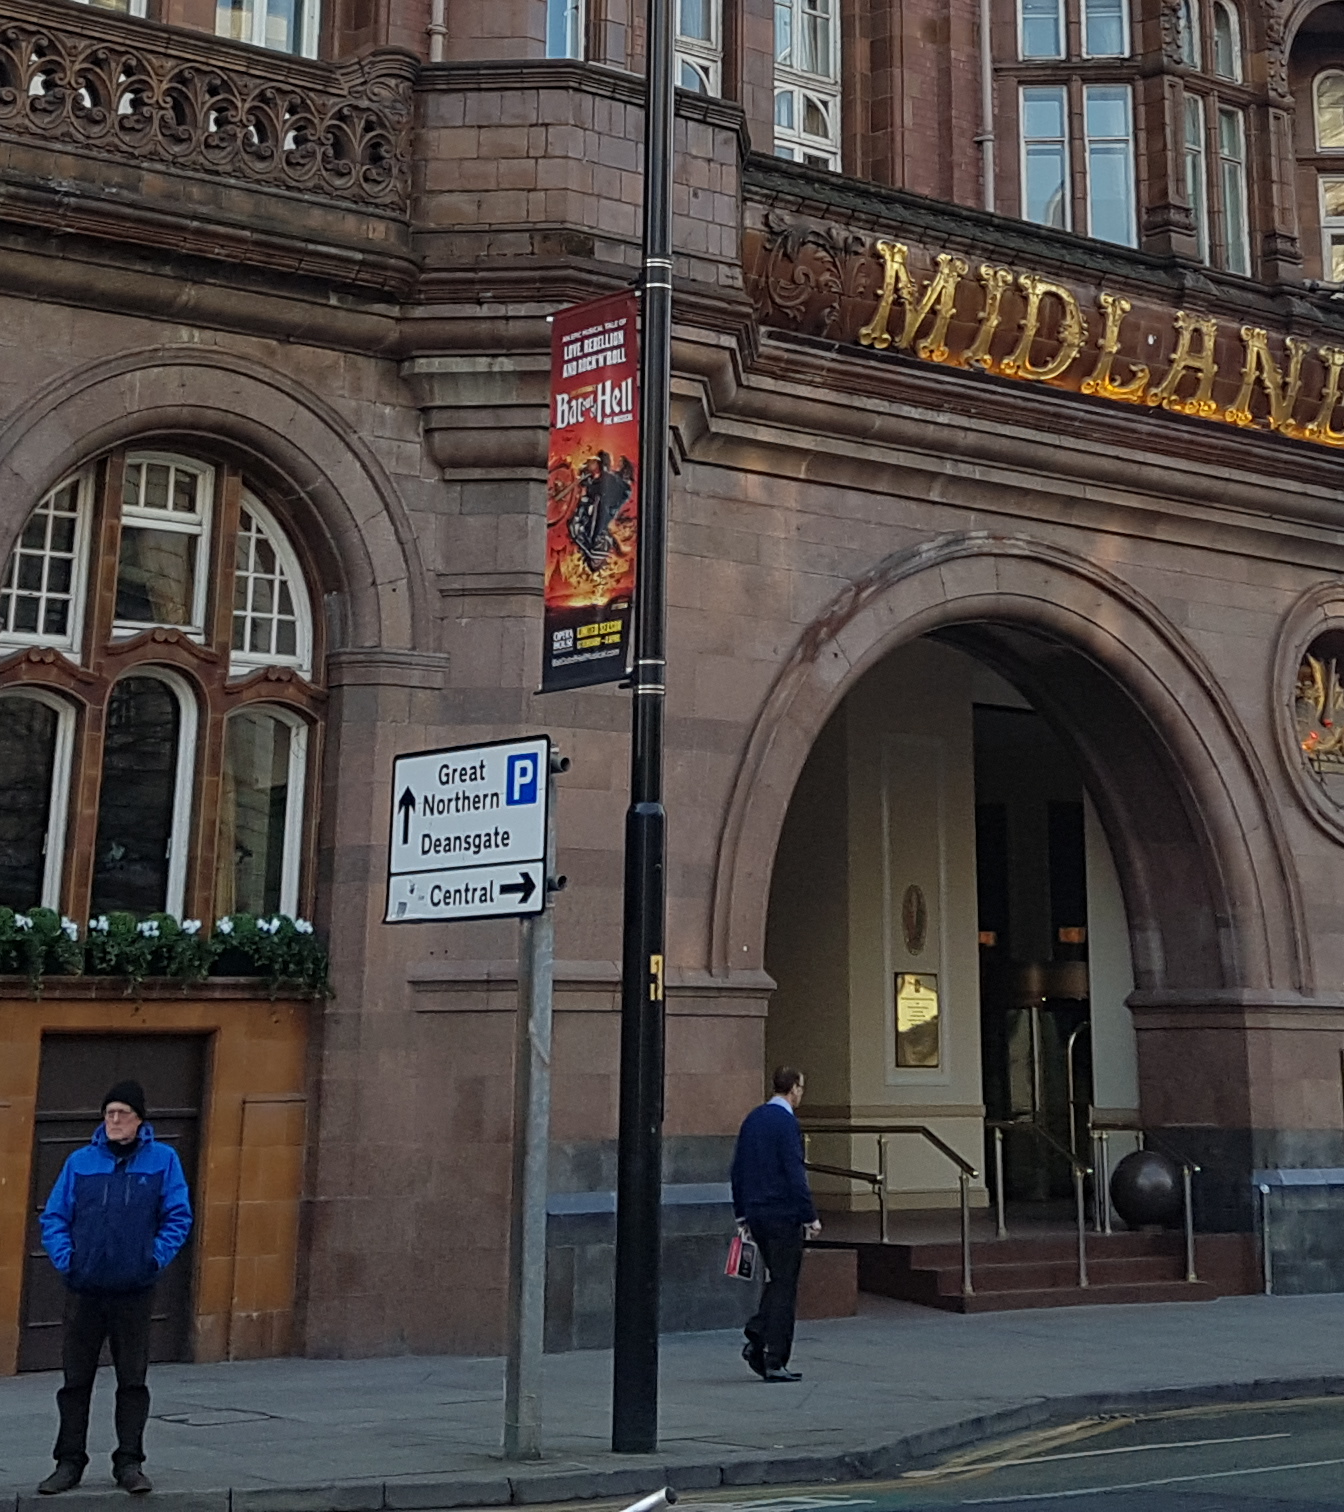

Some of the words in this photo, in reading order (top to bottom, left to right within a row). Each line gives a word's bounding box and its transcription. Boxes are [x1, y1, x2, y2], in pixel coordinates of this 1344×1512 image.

[583, 329, 624, 354] REBELLION
[562, 361, 577, 379] AND
[596, 377, 634, 423] Hell
[438, 759, 486, 786] Great
[422, 790, 500, 817] Northern
[421, 826, 511, 856] Deansgate
[430, 880, 495, 907] Central
